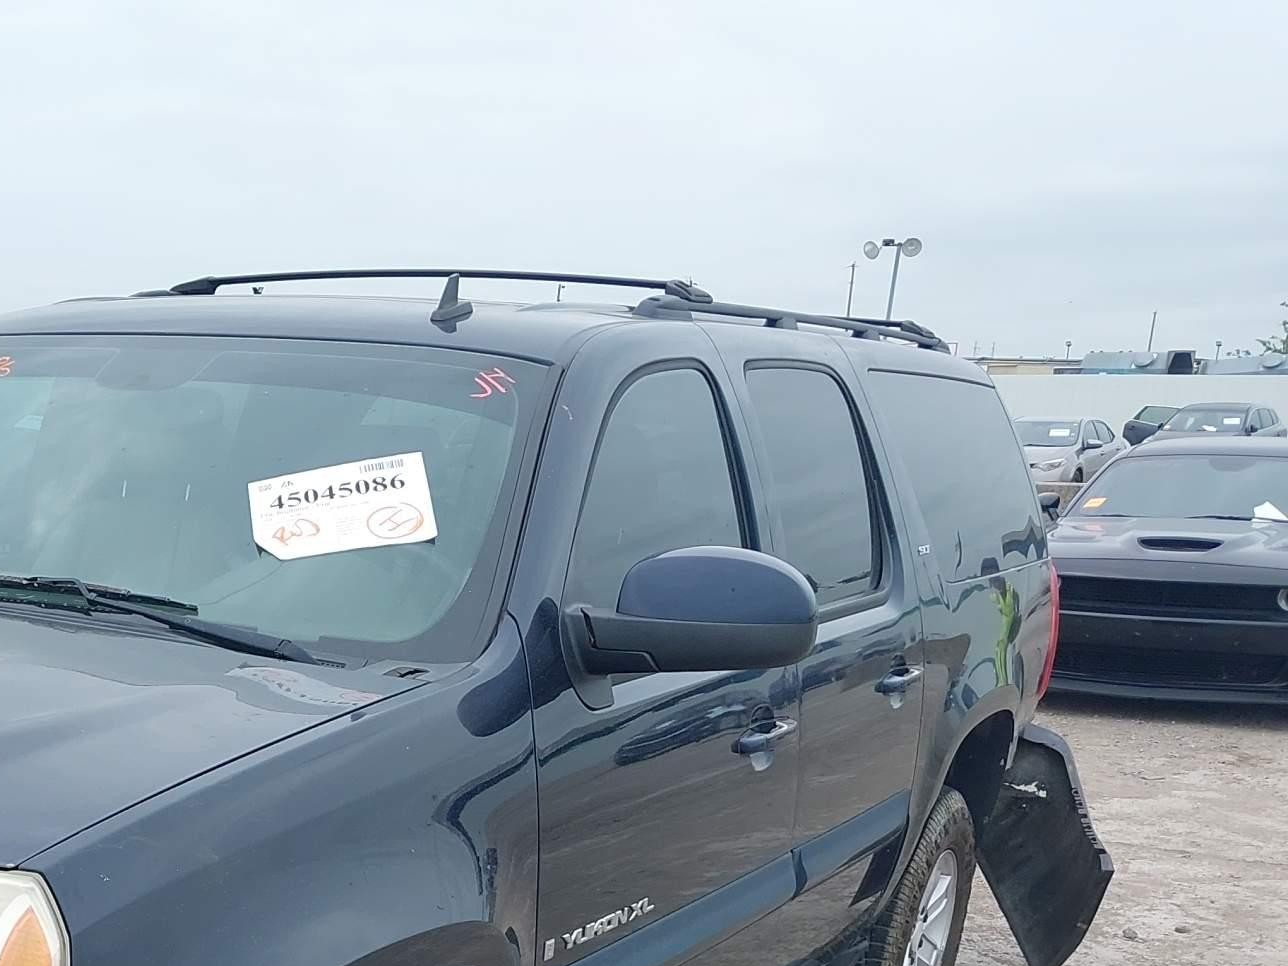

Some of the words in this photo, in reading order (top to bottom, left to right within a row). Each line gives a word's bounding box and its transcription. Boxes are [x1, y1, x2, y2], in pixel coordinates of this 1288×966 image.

[269, 473, 406, 510] 45045086
[561, 906, 629, 950] YUKON
[628, 896, 655, 922] XL
